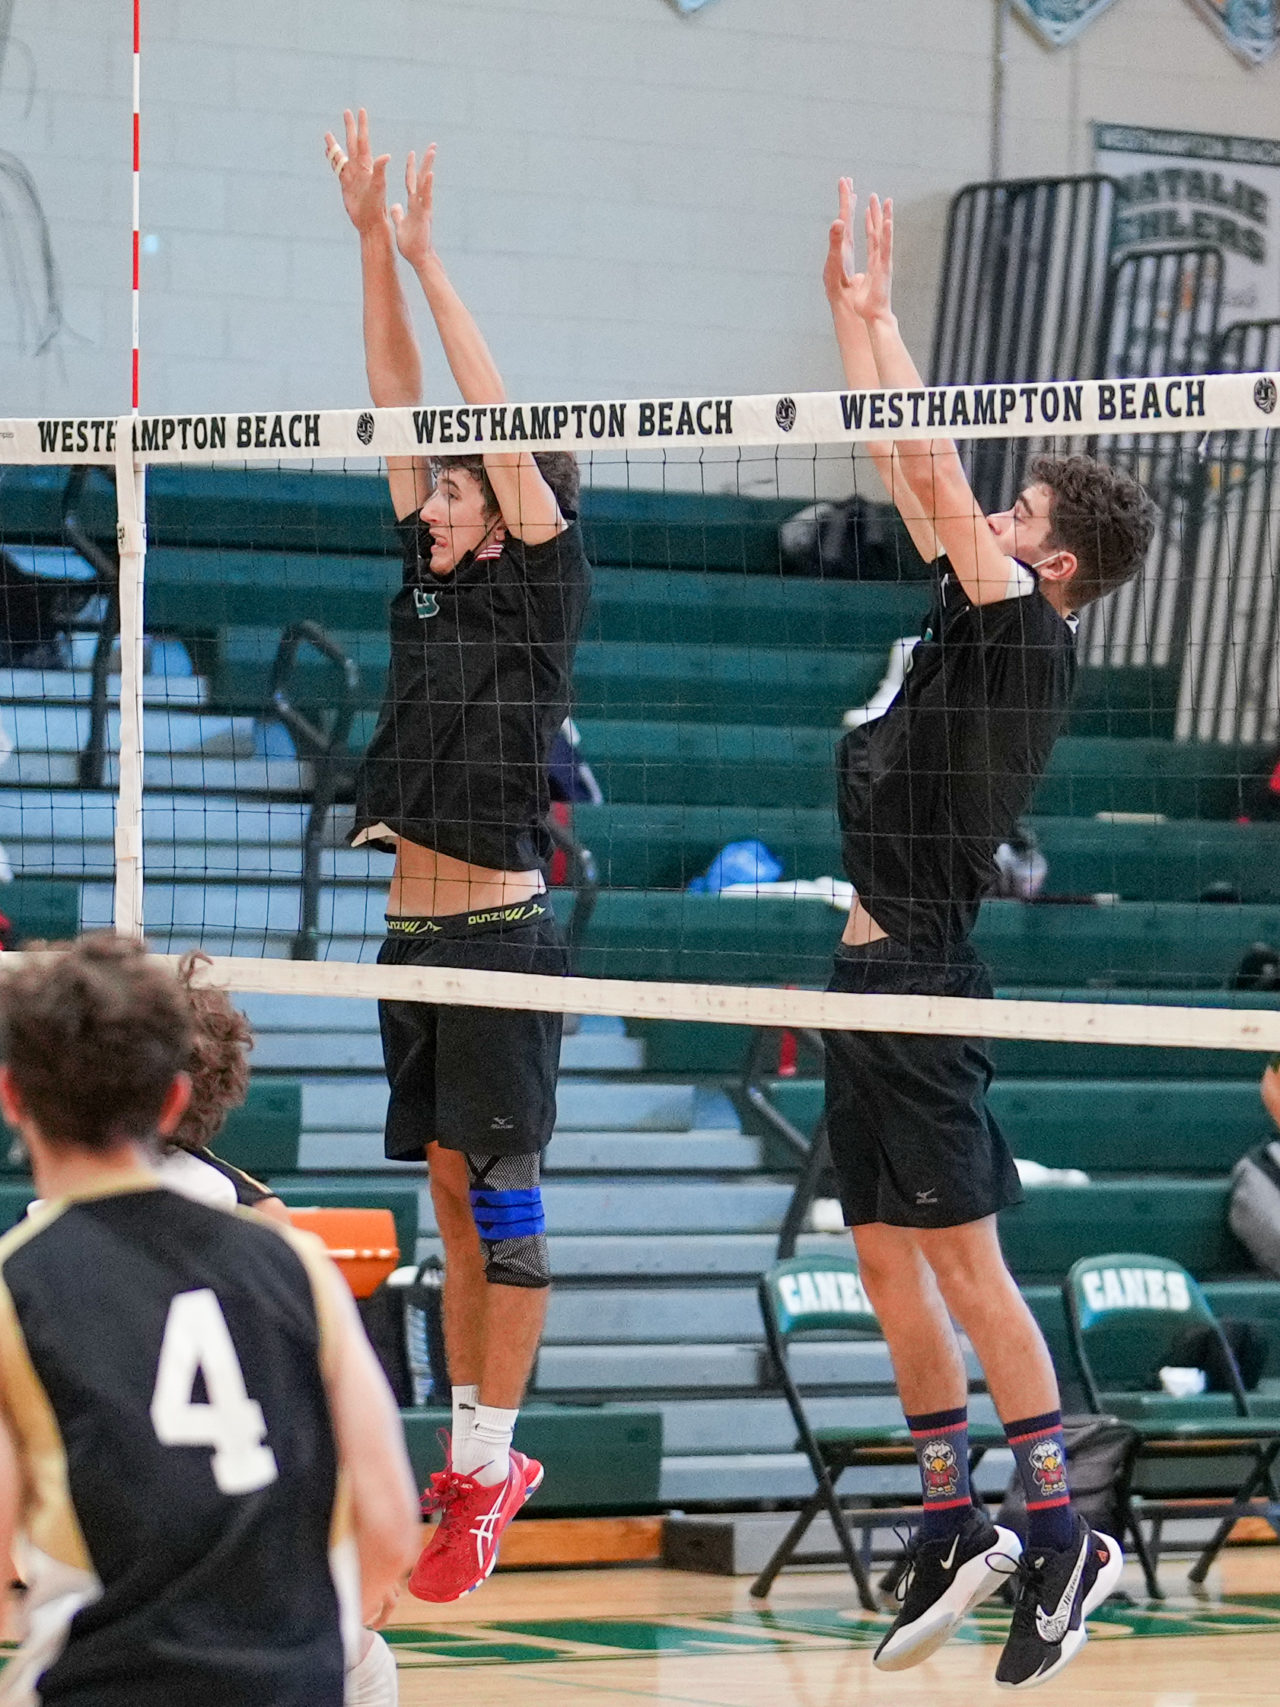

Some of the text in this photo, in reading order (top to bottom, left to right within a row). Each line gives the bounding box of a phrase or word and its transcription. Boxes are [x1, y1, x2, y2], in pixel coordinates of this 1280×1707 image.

[413, 404, 627, 444] WESTHAMPTON
[637, 401, 734, 436] BEACH
[839, 386, 1083, 430] WESTHAMPTON
[1098, 380, 1206, 419] BEACH
[236, 413, 320, 447] BEACH
[778, 1270, 873, 1316] CANE
[1081, 1267, 1191, 1312] CANES
[149, 1286, 280, 1497] 4
